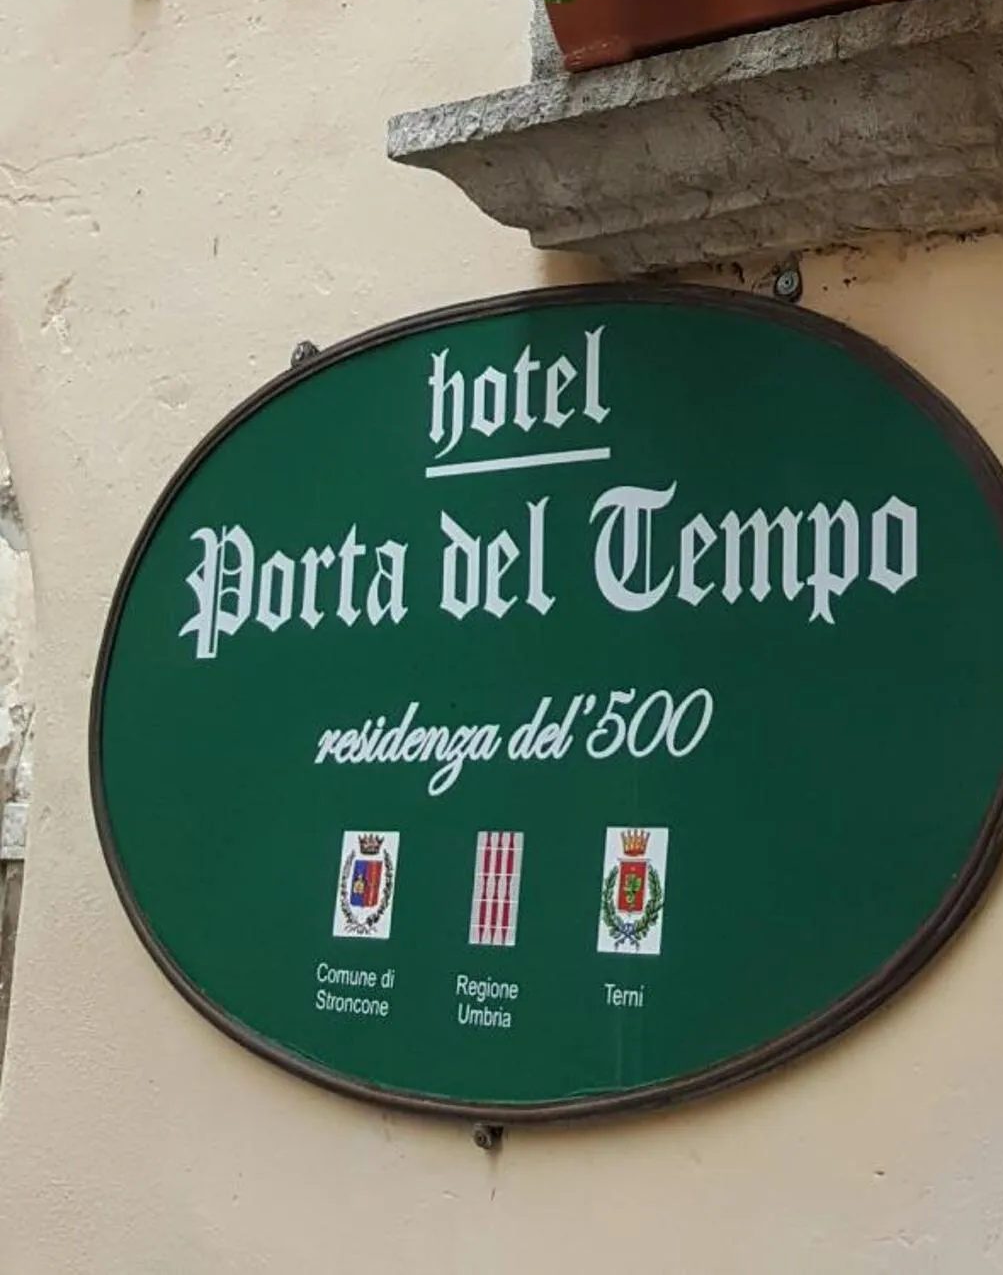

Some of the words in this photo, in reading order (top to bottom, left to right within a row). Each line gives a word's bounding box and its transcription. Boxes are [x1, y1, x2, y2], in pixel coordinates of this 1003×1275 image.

[430, 326, 612, 458] hotel
[178, 523, 409, 659] Porta
[439, 496, 556, 620] del
[588, 480, 919, 625] Tempo
[314, 701, 503, 797] residenza
[316, 962, 377, 988] Comune
[380, 968, 396, 989] di
[456, 974, 520, 1003] Regione
[315, 989, 390, 1017] Stroncone
[604, 983, 645, 1007] Terni
[458, 1003, 513, 1028] Umbria
